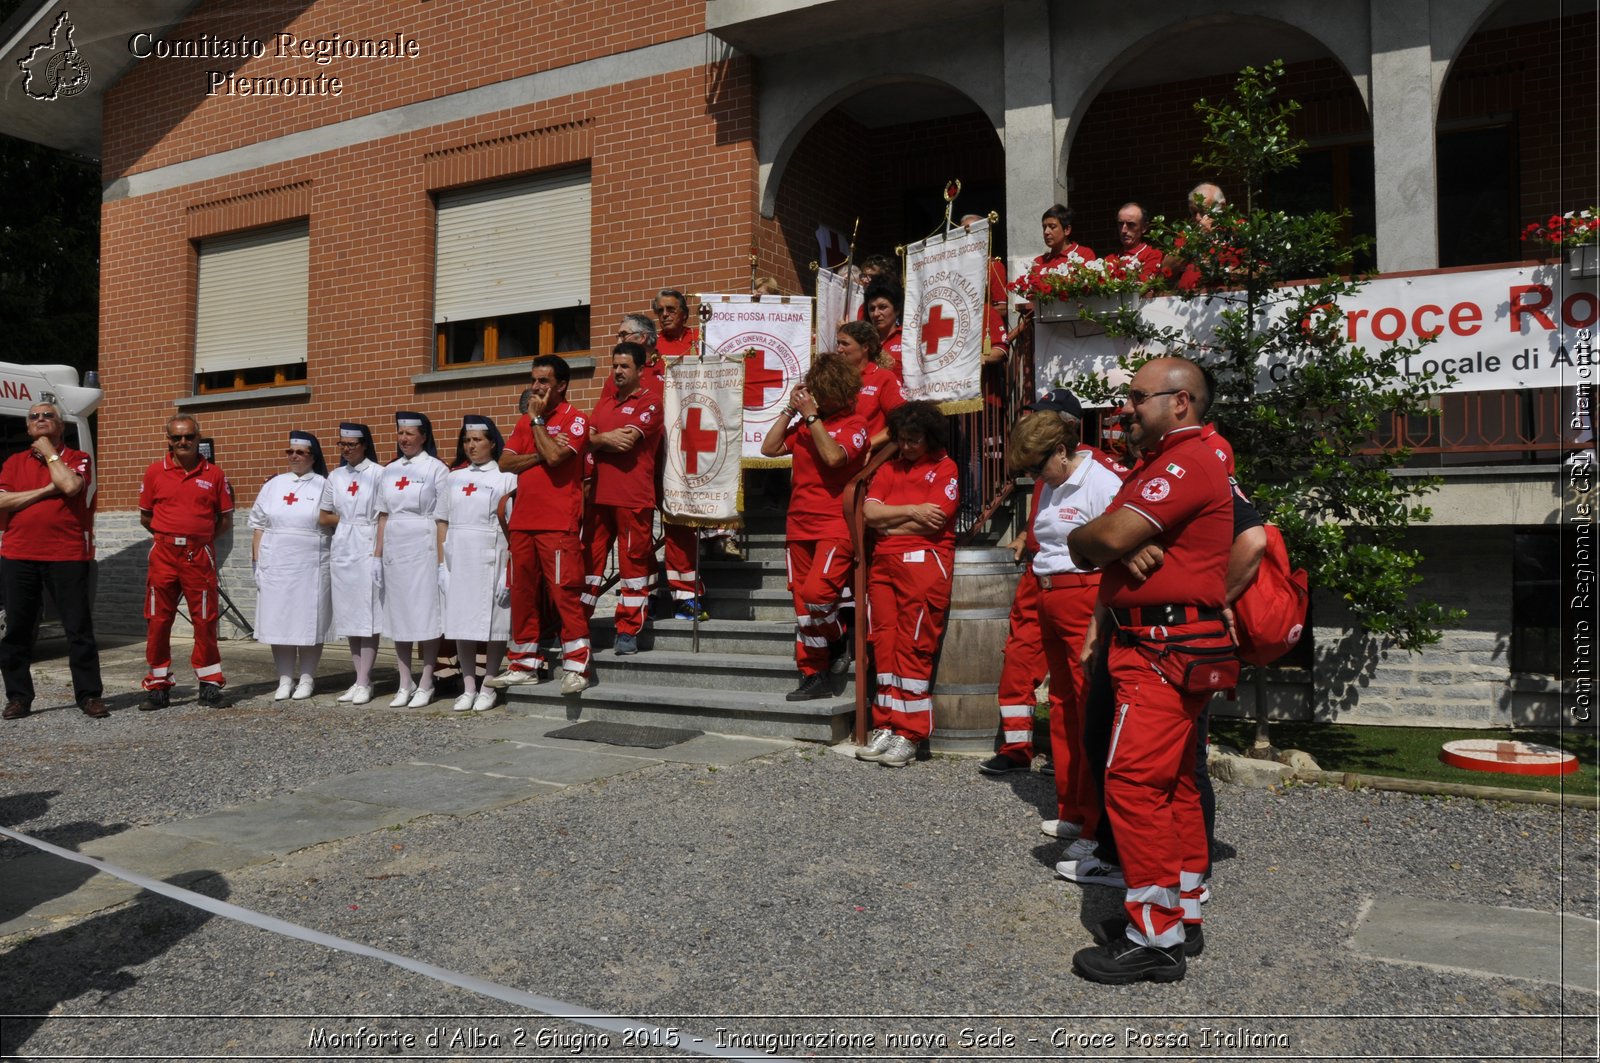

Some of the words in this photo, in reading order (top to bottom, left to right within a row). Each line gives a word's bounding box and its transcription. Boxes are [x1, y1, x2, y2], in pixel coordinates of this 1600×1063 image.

[922, 271, 951, 290] ROSSA
[712, 312, 735, 321] ROCE
[738, 312, 765, 321] ROSSA
[768, 312, 803, 322] ITALIANA
[743, 335, 767, 344] GINEVRA
[1404, 351, 1501, 377] Locale
[1512, 348, 1539, 371] di
